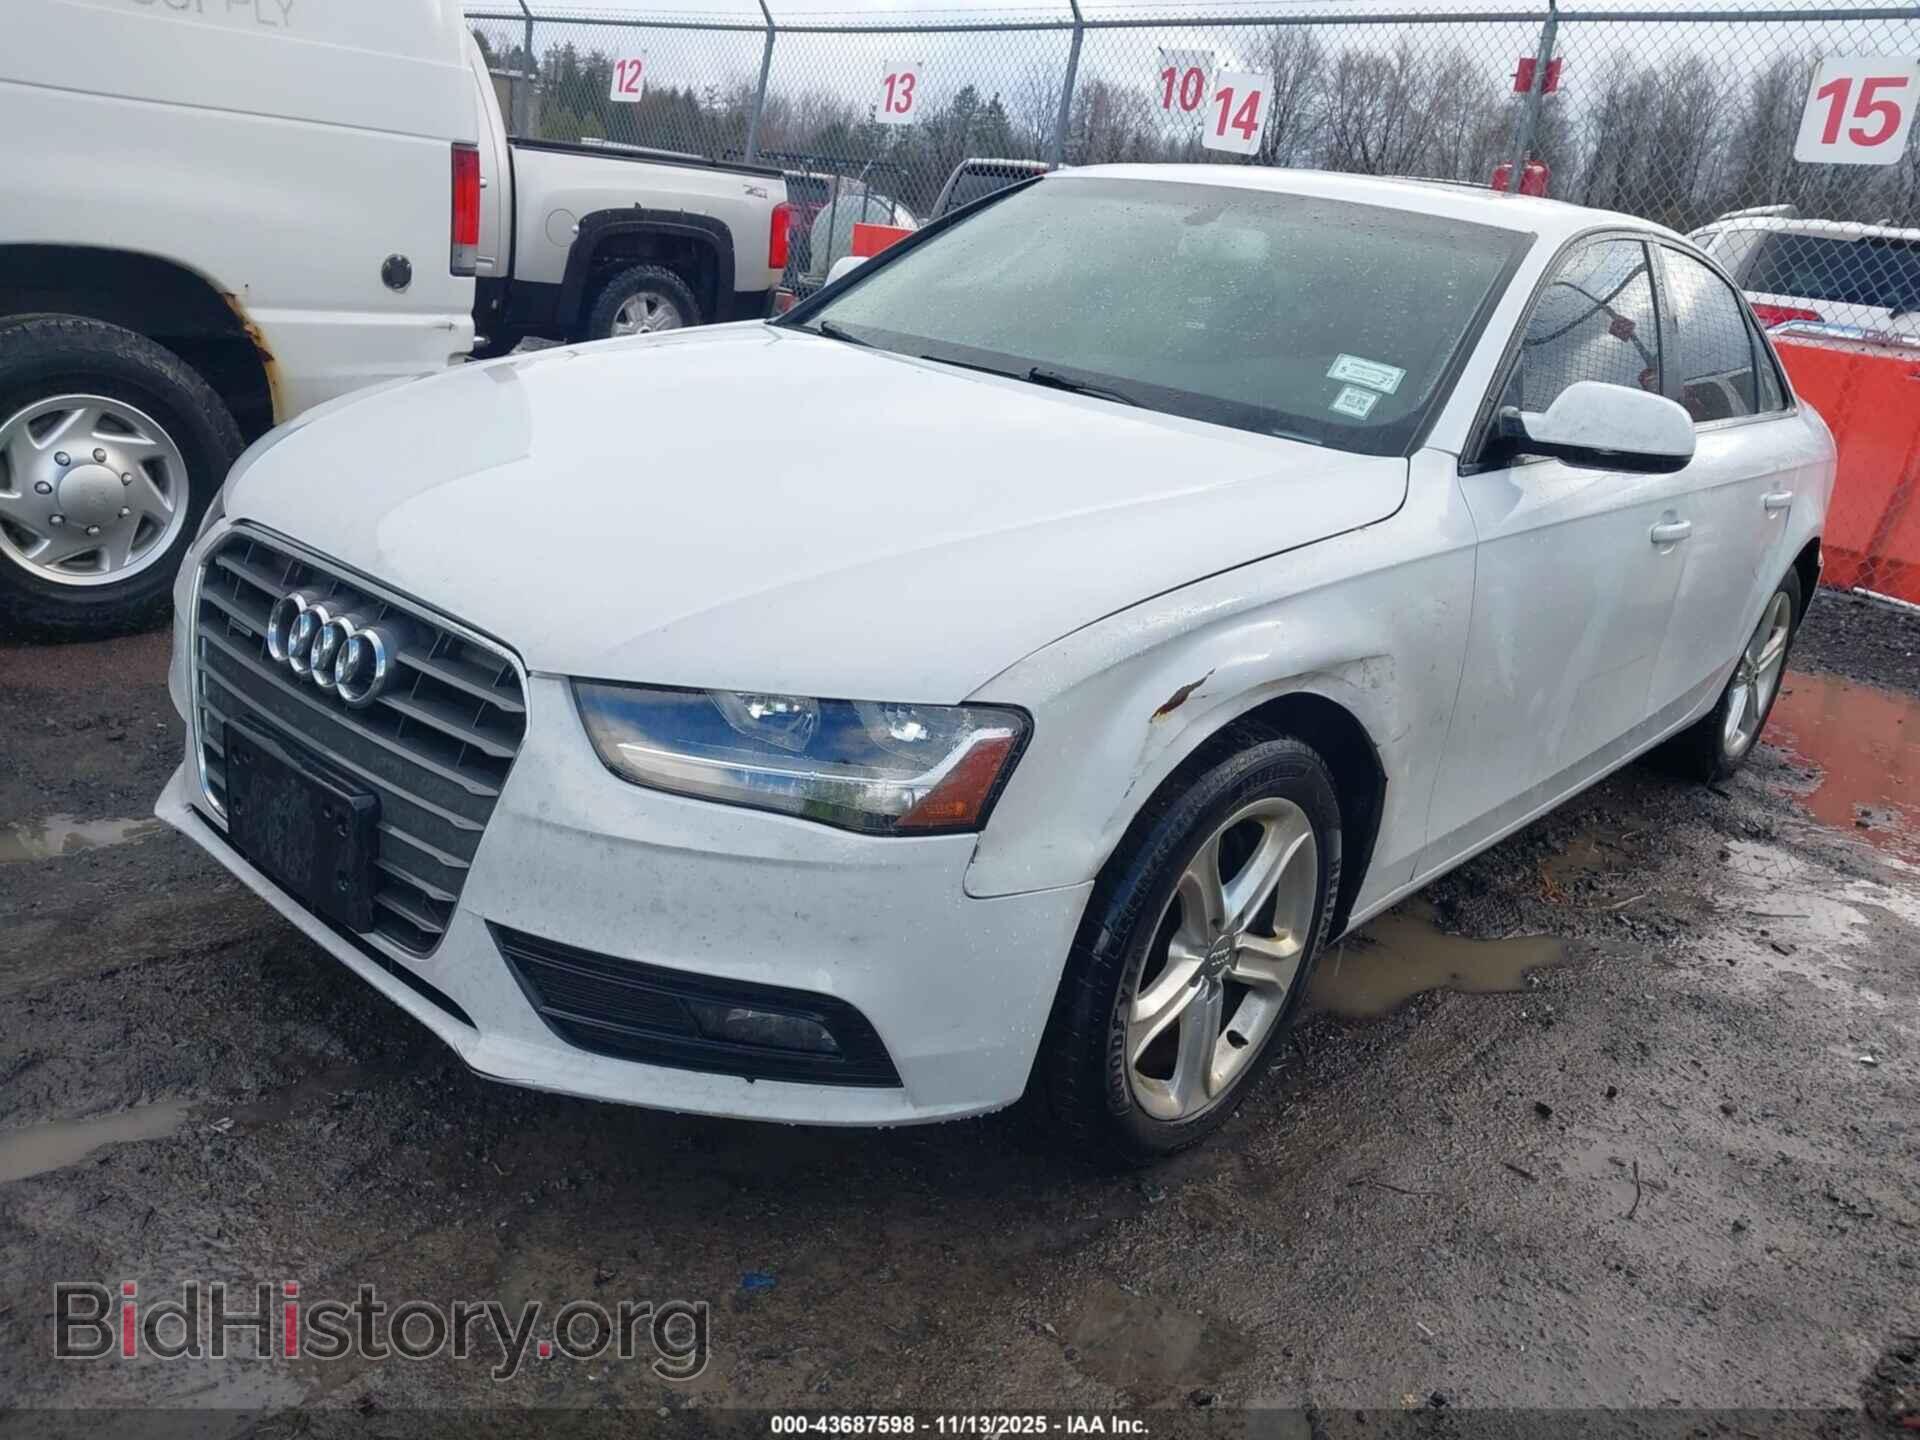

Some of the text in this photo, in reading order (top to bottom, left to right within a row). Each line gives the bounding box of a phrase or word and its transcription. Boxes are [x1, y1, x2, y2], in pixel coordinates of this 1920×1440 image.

[615, 59, 643, 94] 12
[884, 73, 916, 113] 13
[1161, 67, 1205, 112] 10
[1215, 87, 1262, 140] 14
[1816, 77, 1909, 147] 15
